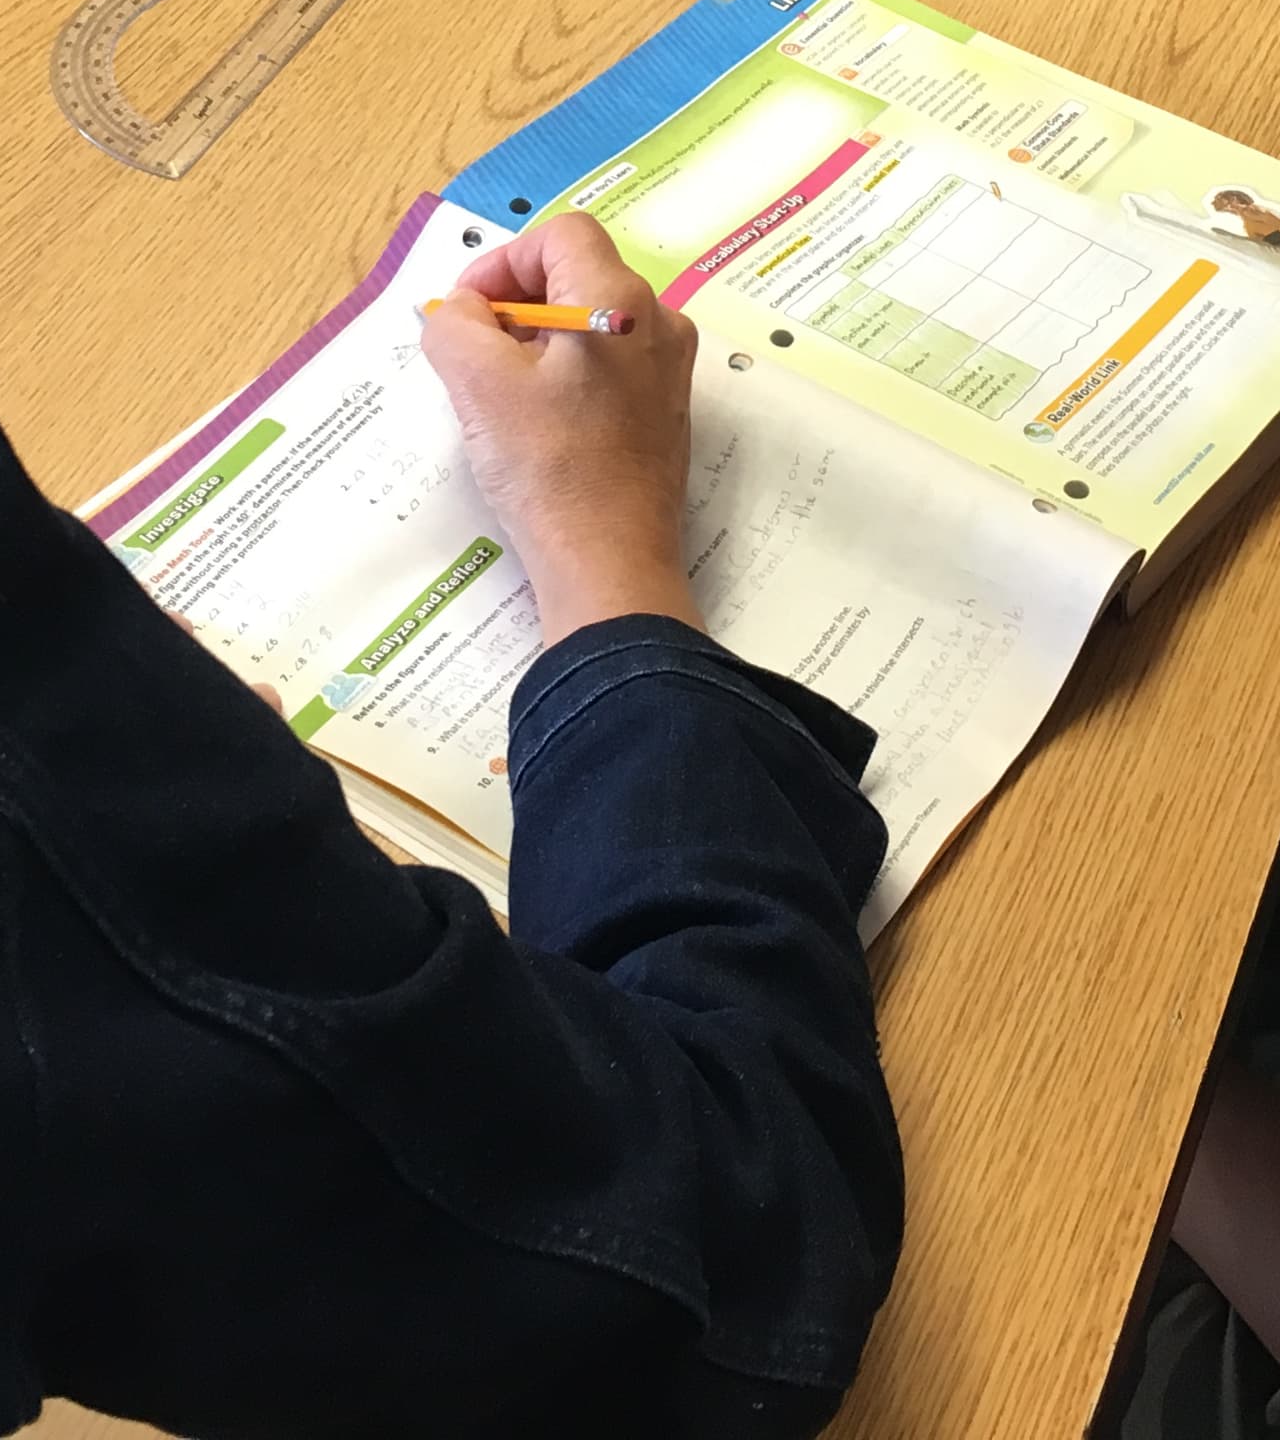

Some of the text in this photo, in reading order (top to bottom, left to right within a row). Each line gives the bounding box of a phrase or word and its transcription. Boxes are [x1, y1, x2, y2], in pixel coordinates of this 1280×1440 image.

[694, 190, 804, 278] Vocabulary Start-Up
[1048, 358, 1120, 423] Real-World Link
[138, 471, 223, 547] Investigate
[157, 569, 187, 594] figure
[182, 558, 195, 570] at
[192, 546, 209, 561] the
[206, 529, 230, 550] right
[251, 471, 291, 508] determine
[291, 453, 309, 469] the
[308, 428, 337, 455] measure
[333, 418, 347, 429] of
[343, 402, 363, 420] each
[360, 383, 385, 406] given
[159, 590, 183, 612] ngle
[181, 562, 213, 592] without
[212, 540, 238, 563] using
[240, 497, 282, 536] protractor.
[281, 477, 303, 497] Then
[301, 456, 325, 478] check
[324, 442, 343, 460] your
[341, 414, 371, 441] answers
[368, 403, 383, 417] by
[167, 546, 192, 568] Math
[213, 503, 238, 526] Work
[236, 487, 255, 505] with
[259, 453, 294, 485] partner.
[295, 434, 312, 449] the
[311, 406, 343, 436] measure
[339, 397, 352, 408] of
[176, 579, 216, 615] easuring
[211, 562, 232, 581] with
[237, 516, 281, 558] protractor.
[696, 528, 729, 564] the same
[359, 543, 492, 673] Analyze and Reflect
[801, 651, 815, 665] by
[809, 620, 838, 653] another
[833, 603, 852, 623] line.
[816, 605, 871, 675] your estimates by
[352, 627, 451, 721] Refer to the figure above.
[385, 695, 410, 718] What
[413, 677, 429, 691] the
[425, 636, 473, 681] relationship
[468, 606, 502, 638] between
[498, 595, 513, 609] the
[510, 582, 526, 597] two
[864, 672, 885, 694] third
[879, 656, 897, 674] line
[888, 615, 928, 659] intersects
[438, 721, 462, 743] What
[464, 701, 483, 718] true
[479, 680, 503, 703] about
[500, 667, 517, 682] the
[477, 774, 494, 789] 10.
